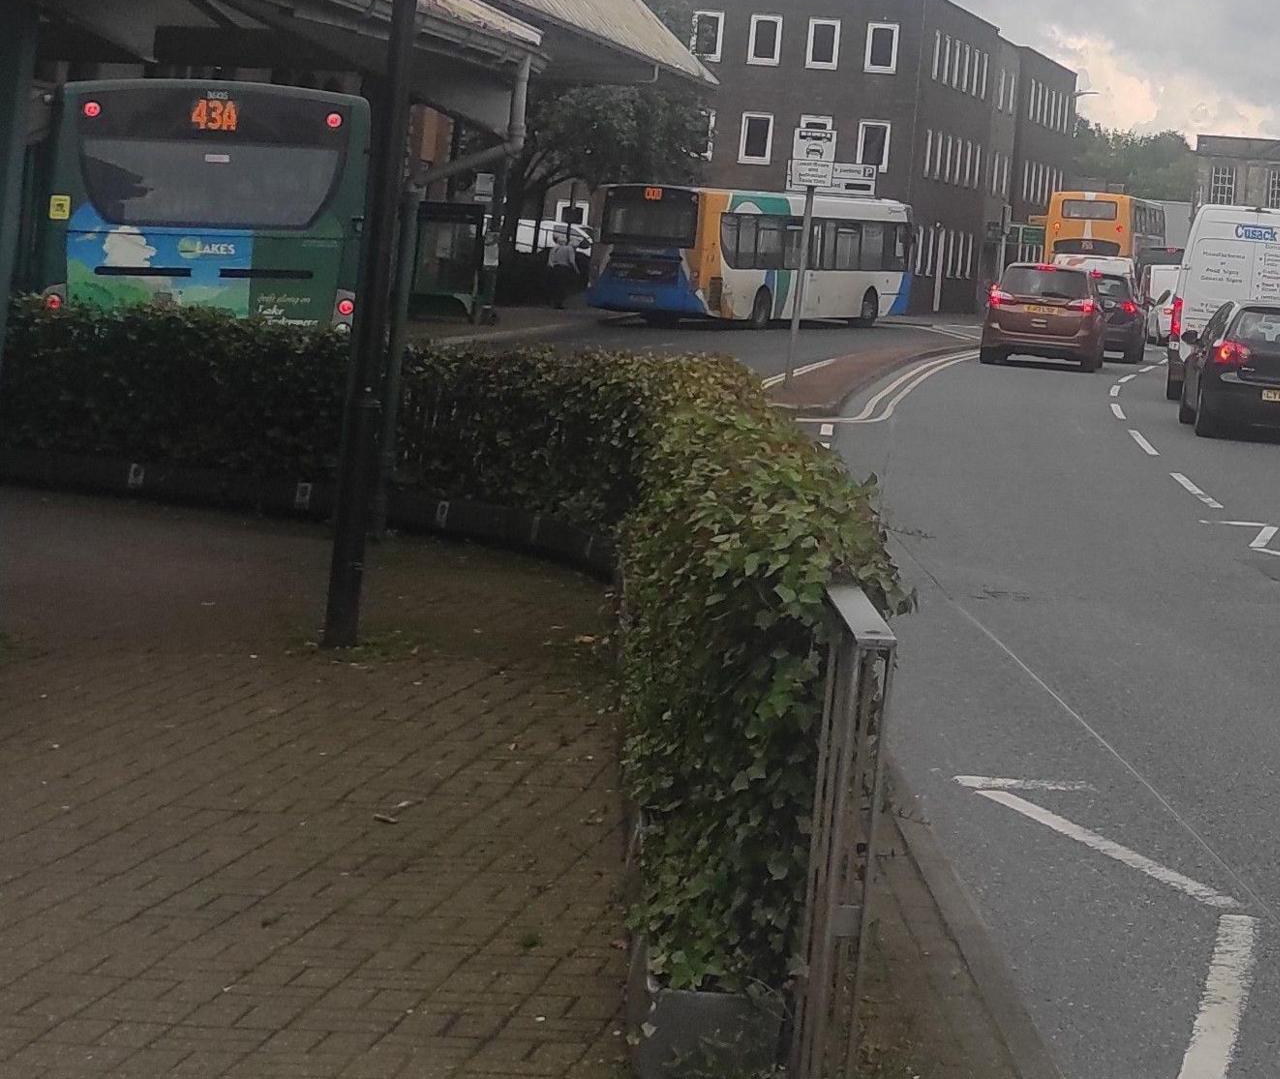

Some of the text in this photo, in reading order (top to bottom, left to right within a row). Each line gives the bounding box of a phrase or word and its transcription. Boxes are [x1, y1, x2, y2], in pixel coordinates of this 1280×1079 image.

[192, 99, 237, 131] 43A
[1235, 224, 1278, 241] Cusack
[195, 241, 236, 255] LAKES
